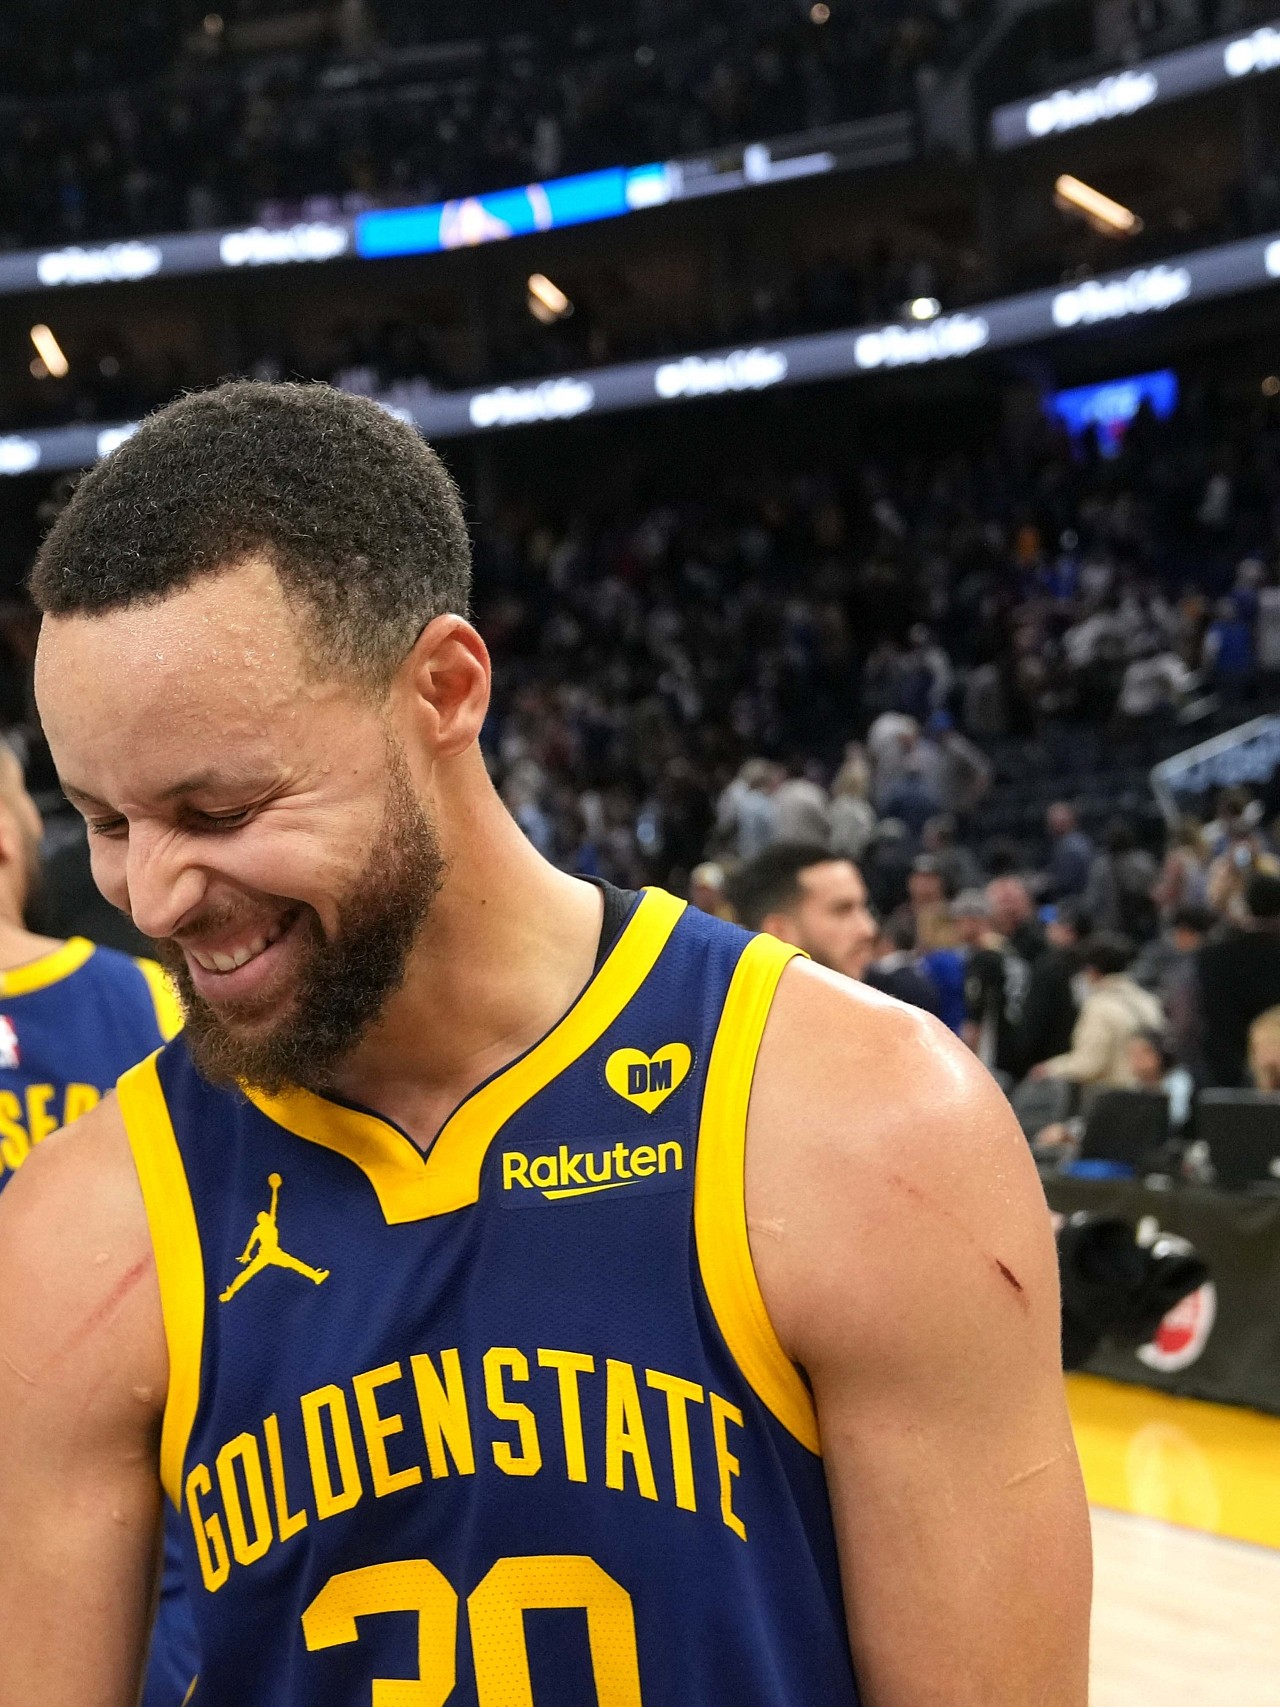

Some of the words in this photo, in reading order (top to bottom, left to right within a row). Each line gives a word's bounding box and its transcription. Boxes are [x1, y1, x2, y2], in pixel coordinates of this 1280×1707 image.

[628, 1059, 672, 1095] DM
[502, 1141, 683, 1190] Rakuten
[185, 1348, 475, 1593] GOLDEN
[483, 1347, 748, 1542] STATE
